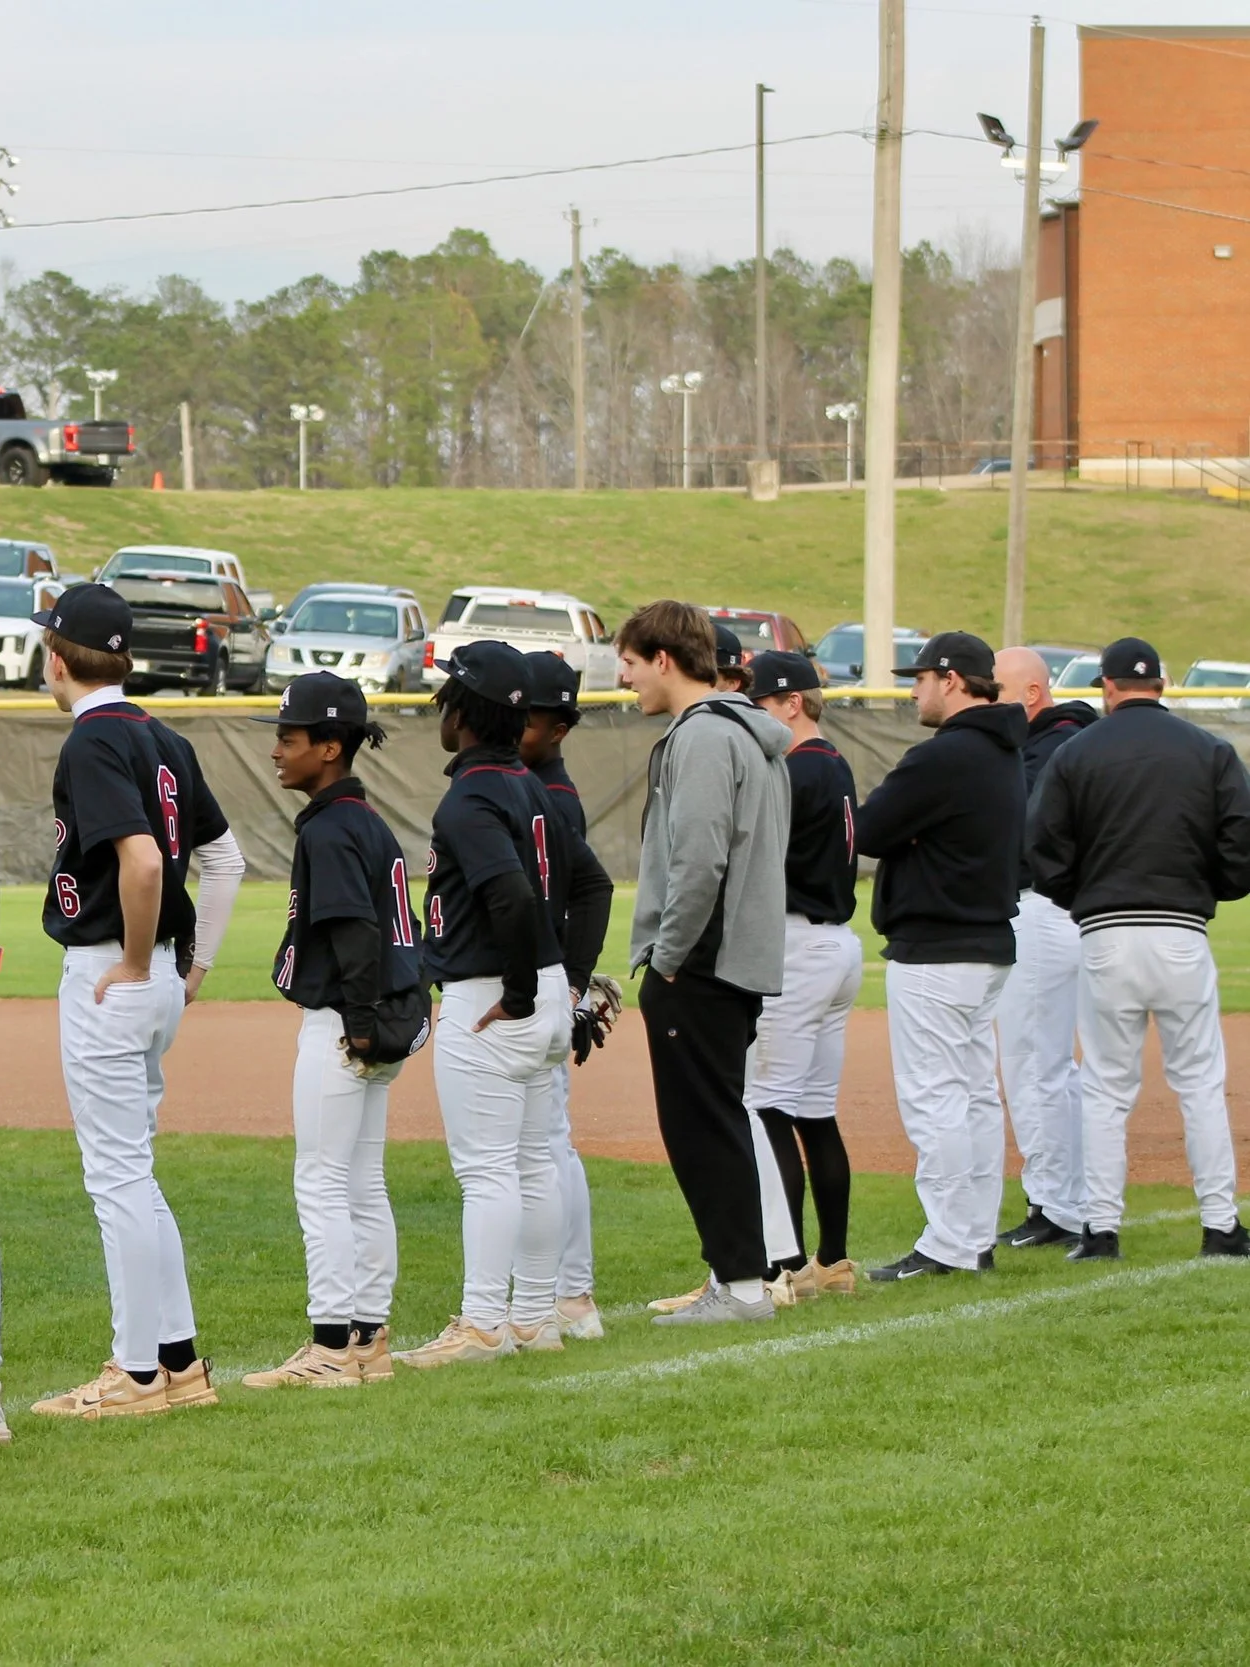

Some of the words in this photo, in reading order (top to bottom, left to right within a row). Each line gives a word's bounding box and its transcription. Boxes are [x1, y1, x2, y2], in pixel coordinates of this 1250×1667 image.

[156, 764, 180, 860] 6
[55, 873, 81, 918] 6
[430, 895, 443, 937] 4
